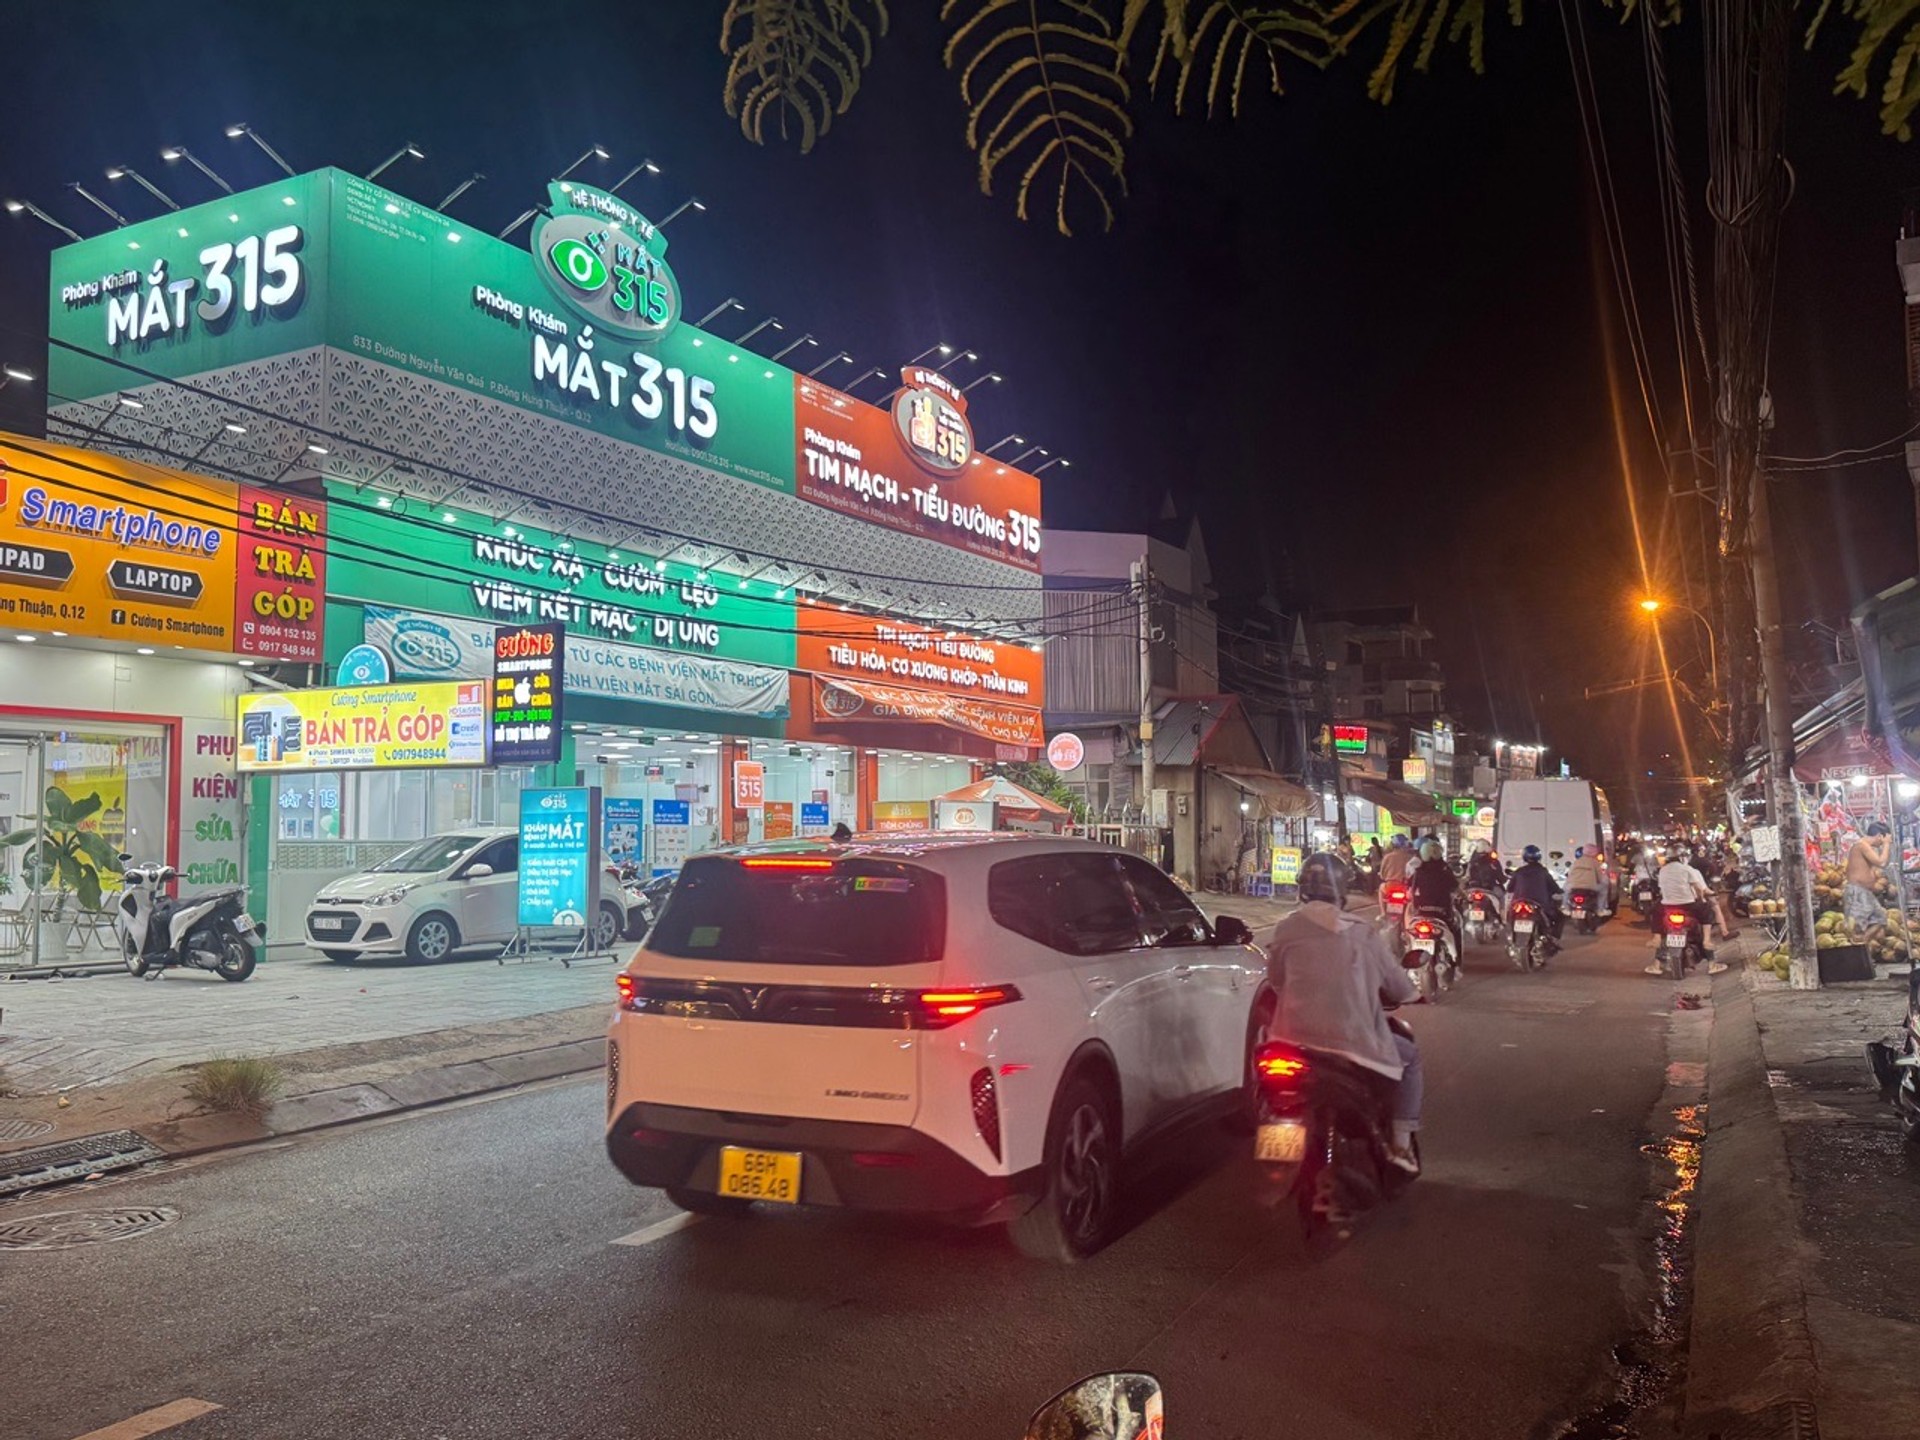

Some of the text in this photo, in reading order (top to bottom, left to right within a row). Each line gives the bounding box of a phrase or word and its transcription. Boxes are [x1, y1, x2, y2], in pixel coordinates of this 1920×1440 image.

[572, 189, 656, 240] HỆ THỐNG Y TẾ
[617, 242, 662, 278] MẮT
[62, 268, 139, 304] Phòng Khám
[107, 225, 299, 345] MẮT 315
[613, 265, 669, 325] 315
[476, 285, 568, 336] Phòng Khám
[353, 334, 372, 351] 833
[374, 342, 407, 365] Đường
[409, 353, 445, 377] Nguyễn
[446, 366, 465, 382] Văn
[466, 373, 485, 389] Quá
[533, 326, 628, 408] MẮT
[631, 352, 718, 439] 315
[804, 427, 861, 461] Phòng Khám
[937, 425, 966, 465] 315
[804, 448, 840, 484] TIM
[844, 462, 898, 505] MẠCH
[912, 483, 949, 522] TIỂU
[951, 504, 1006, 542] ĐƯỜNG
[1007, 509, 1040, 553] 315
[20, 487, 222, 554] Smartphone
[254, 498, 318, 538] BÁN
[254, 543, 317, 580] TRẢ
[475, 533, 544, 570] KHÚC
[124, 566, 193, 593] LAPTOP
[18, 598, 86, 619] Thuận, Q.12
[253, 586, 315, 621] GÓP
[165, 617, 225, 637] Smartphone
[259, 624, 317, 641] 0904 152 135
[258, 640, 315, 656] 0917 948 944
[425, 645, 455, 663] 315
[496, 629, 554, 658] CƯỜNG
[959, 641, 995, 665] ĐƯỜNG
[570, 646, 591, 663] TỪ
[595, 650, 625, 668] CÁC
[629, 655, 666, 675] BỆNH
[668, 661, 697, 681] VIỆN
[701, 664, 726, 681] MẮT
[861, 647, 887, 672] HÓA
[911, 660, 948, 682] XƯƠNG
[950, 666, 978, 687] KHỚP
[981, 669, 1006, 692] THẦN
[1007, 678, 1029, 695] KINH
[362, 690, 417, 706] Smartphone
[563, 671, 685, 700] ỆNH VIỆN MẮT SÀI
[305, 705, 444, 746] BÁN TRẢ GÓP
[873, 704, 899, 716] GIA
[991, 727, 1010, 739] CHỢ
[196, 735, 236, 762] PHỤ
[391, 748, 447, 760] 0917948944
[192, 772, 238, 803] KIỆN
[552, 798, 567, 809] 315
[739, 781, 761, 798] 315
[194, 812, 234, 842] SỬA
[548, 814, 585, 840] MẮT
[187, 858, 239, 885] CHỮA
[744, 1153, 778, 1174] 66H
[728, 1174, 789, 1199] 086.48
